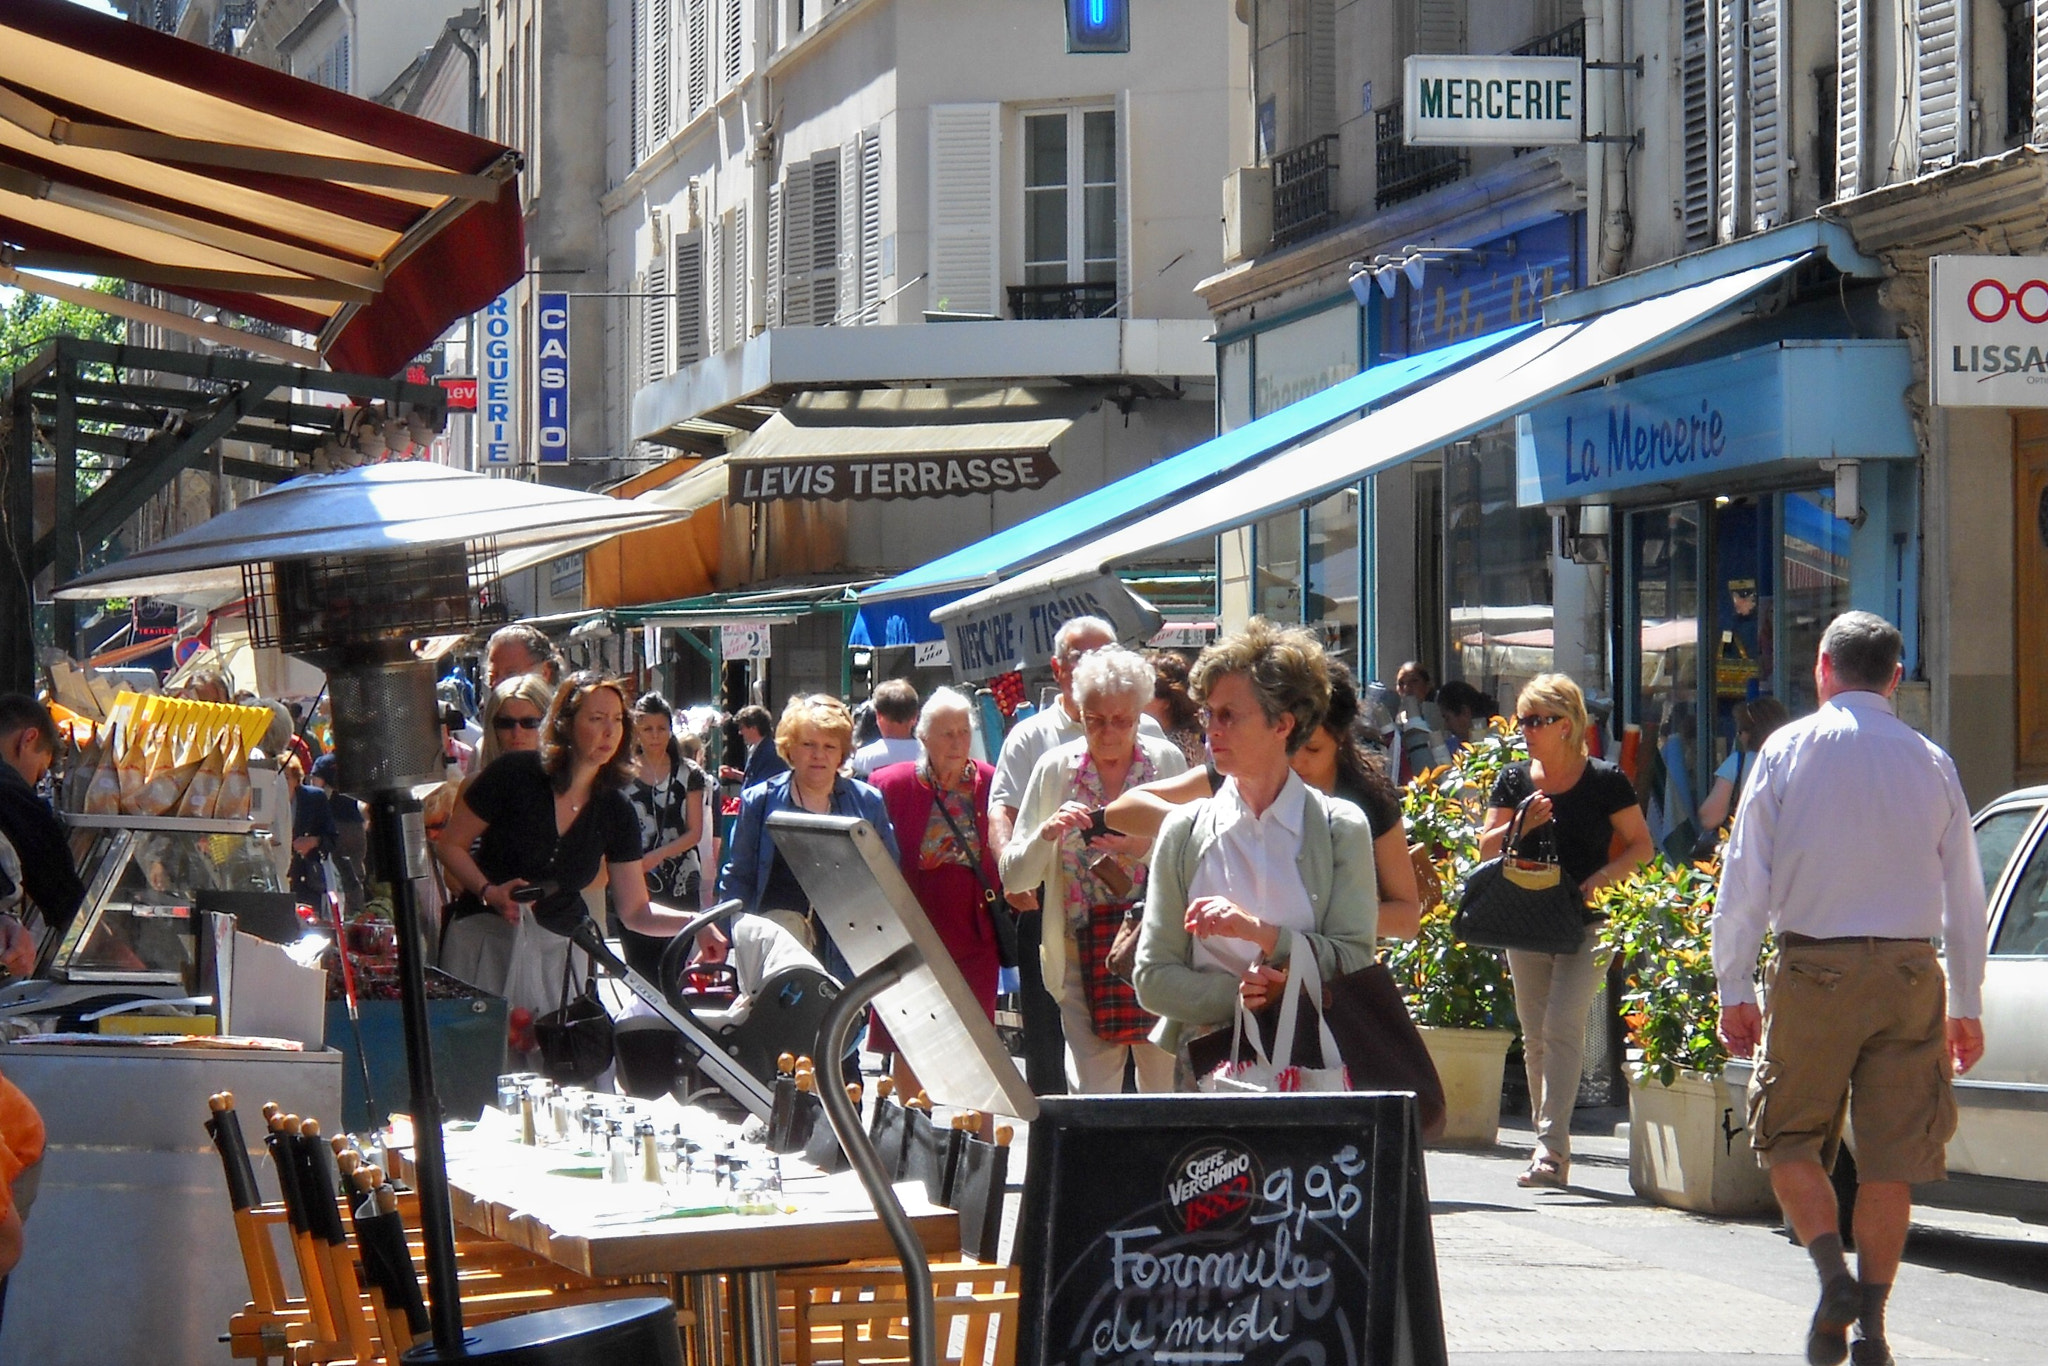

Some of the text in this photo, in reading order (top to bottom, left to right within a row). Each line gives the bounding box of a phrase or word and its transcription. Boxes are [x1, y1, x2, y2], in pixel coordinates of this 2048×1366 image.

[1419, 78, 1572, 120] MERCERIE
[539, 308, 567, 448] CASIO
[1952, 344, 2048, 373] LISSA
[1565, 398, 1726, 486] La Mercerie
[742, 456, 1040, 499] LEVIS TERRASSE
[1168, 1153, 1250, 1207] VERGNANO
[1105, 1221, 1332, 1291] Formule
[1164, 1294, 1291, 1348] midi
